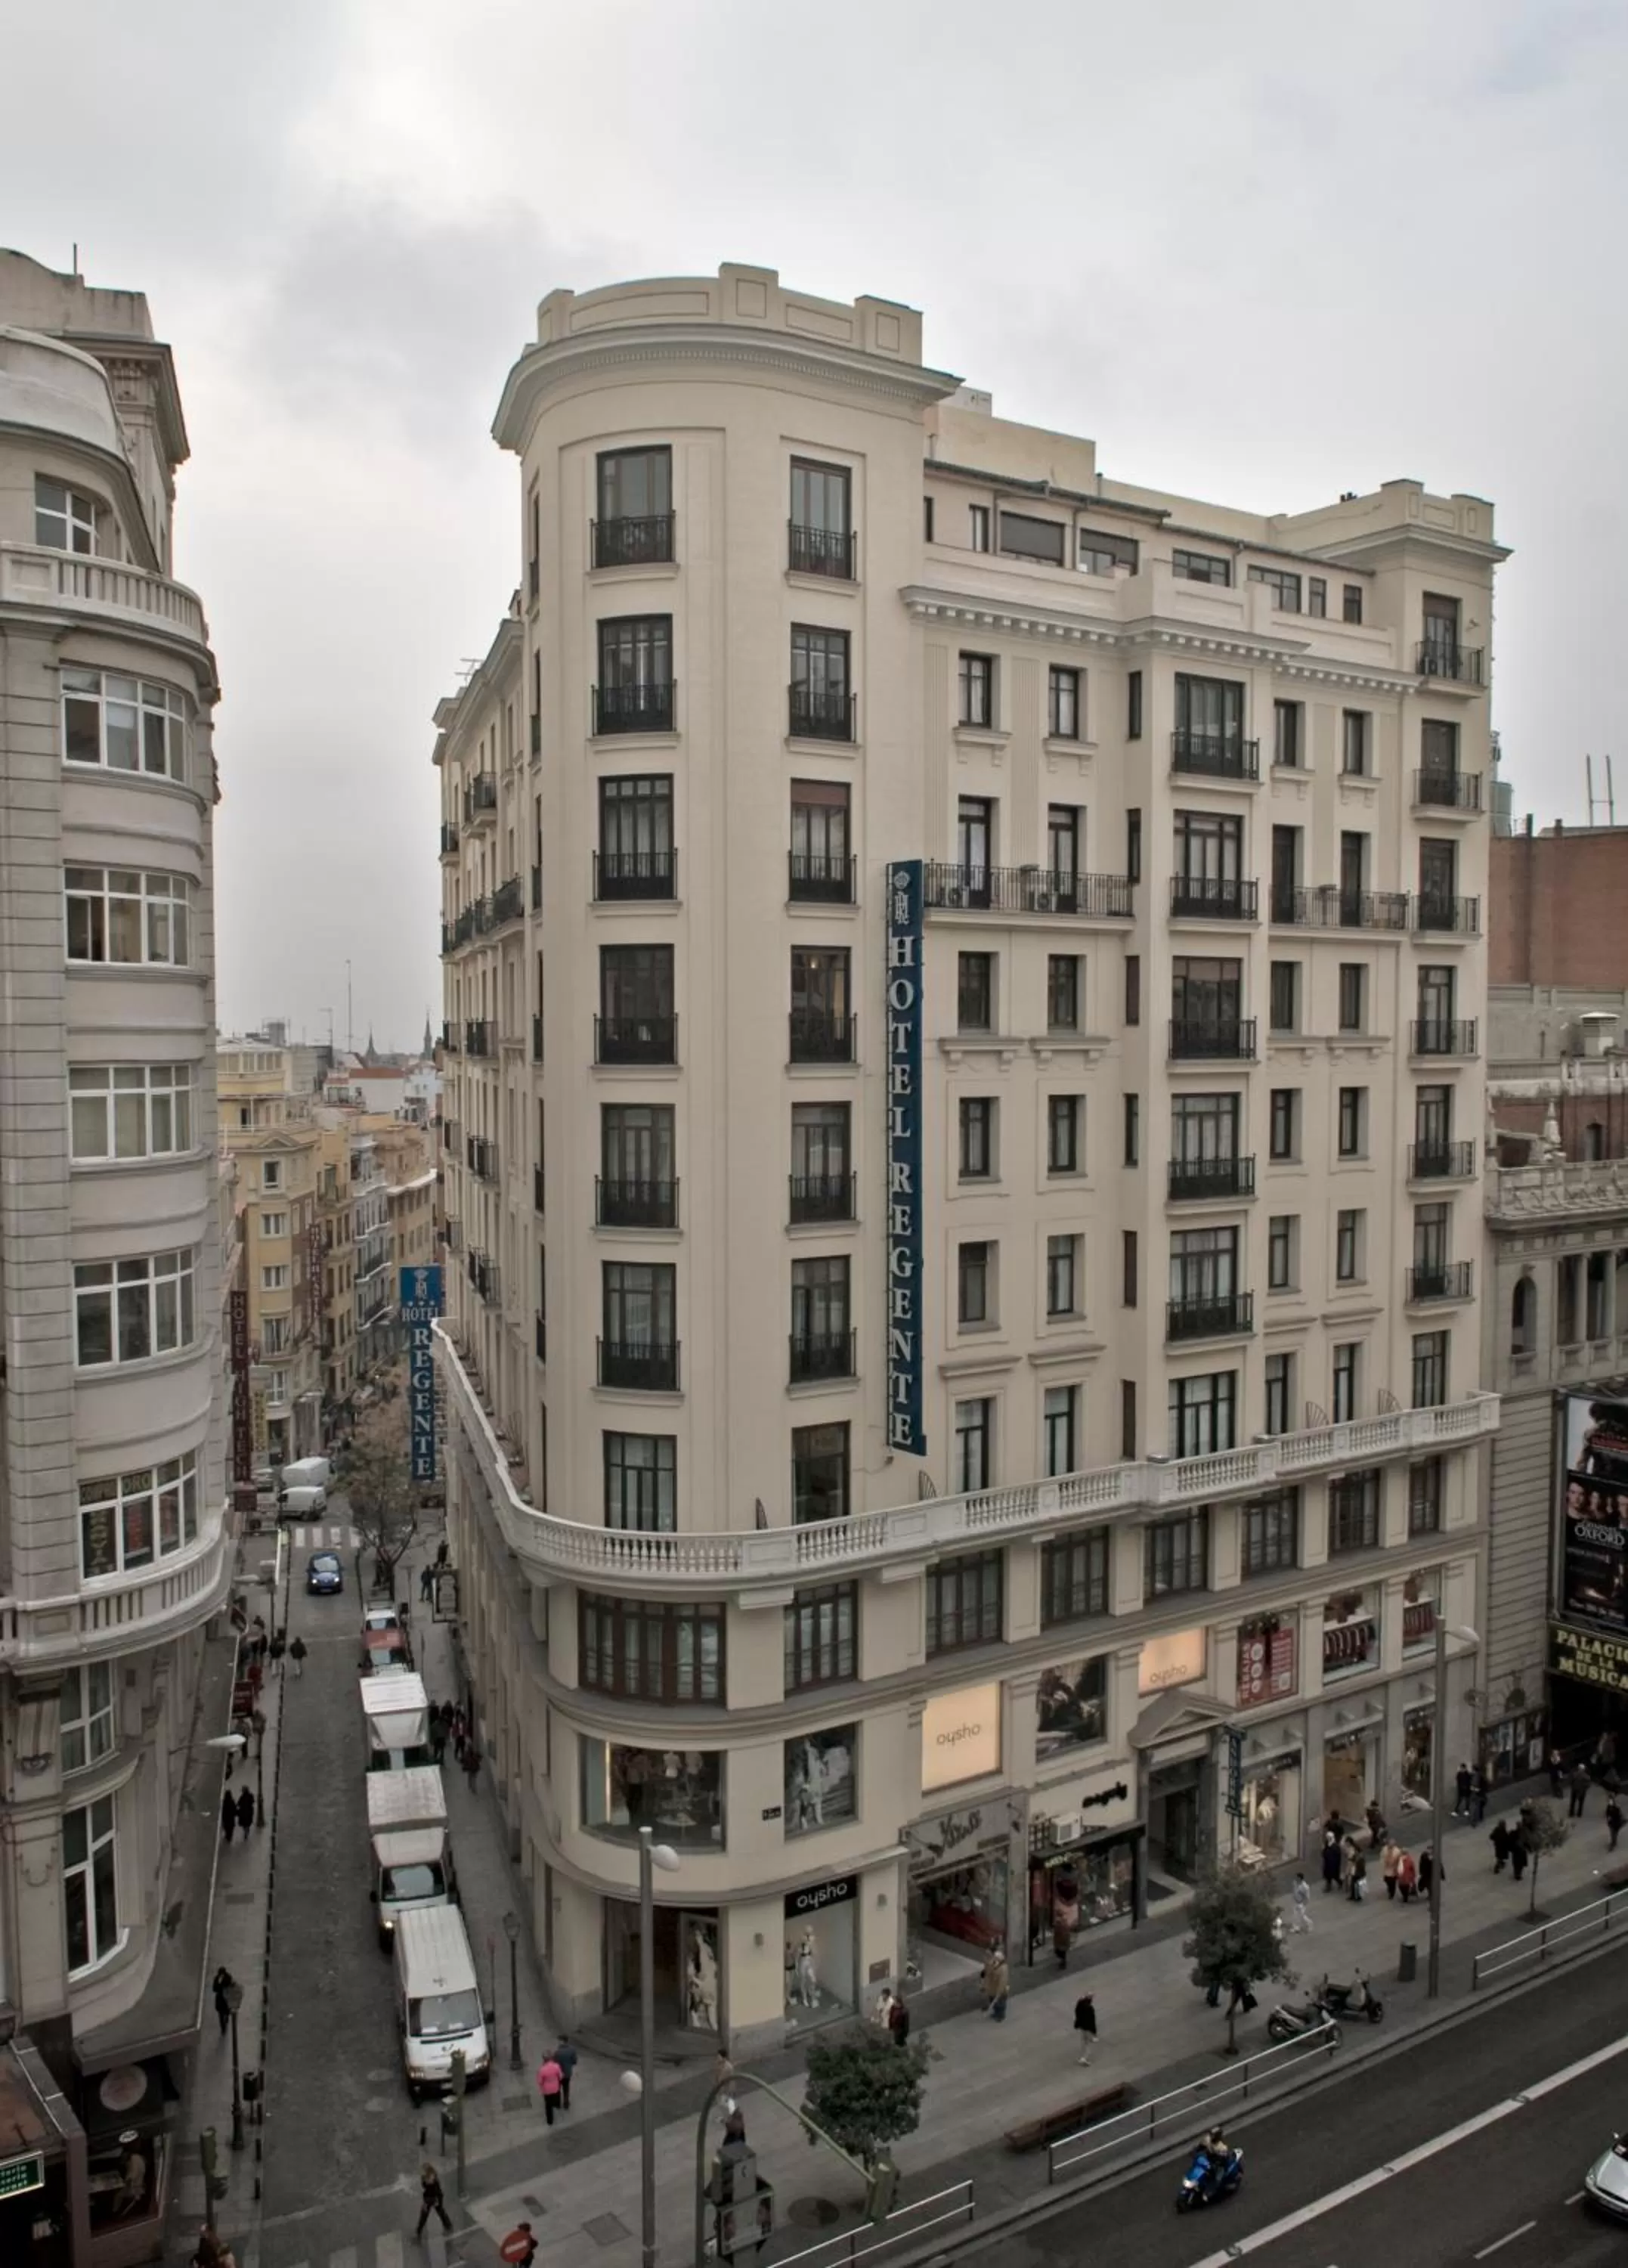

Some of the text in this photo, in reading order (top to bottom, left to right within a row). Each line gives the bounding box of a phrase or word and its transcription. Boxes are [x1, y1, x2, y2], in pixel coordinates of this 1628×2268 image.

[889, 935, 915, 1138] HOTEL
[233, 1294, 245, 1359] HOTEL
[890, 1161, 914, 1445] REGENTE
[412, 1328, 432, 1476] REGENTE
[1576, 1650, 1592, 1662] DE
[936, 1722, 981, 1746] oysho
[797, 1882, 847, 1908] oysho
